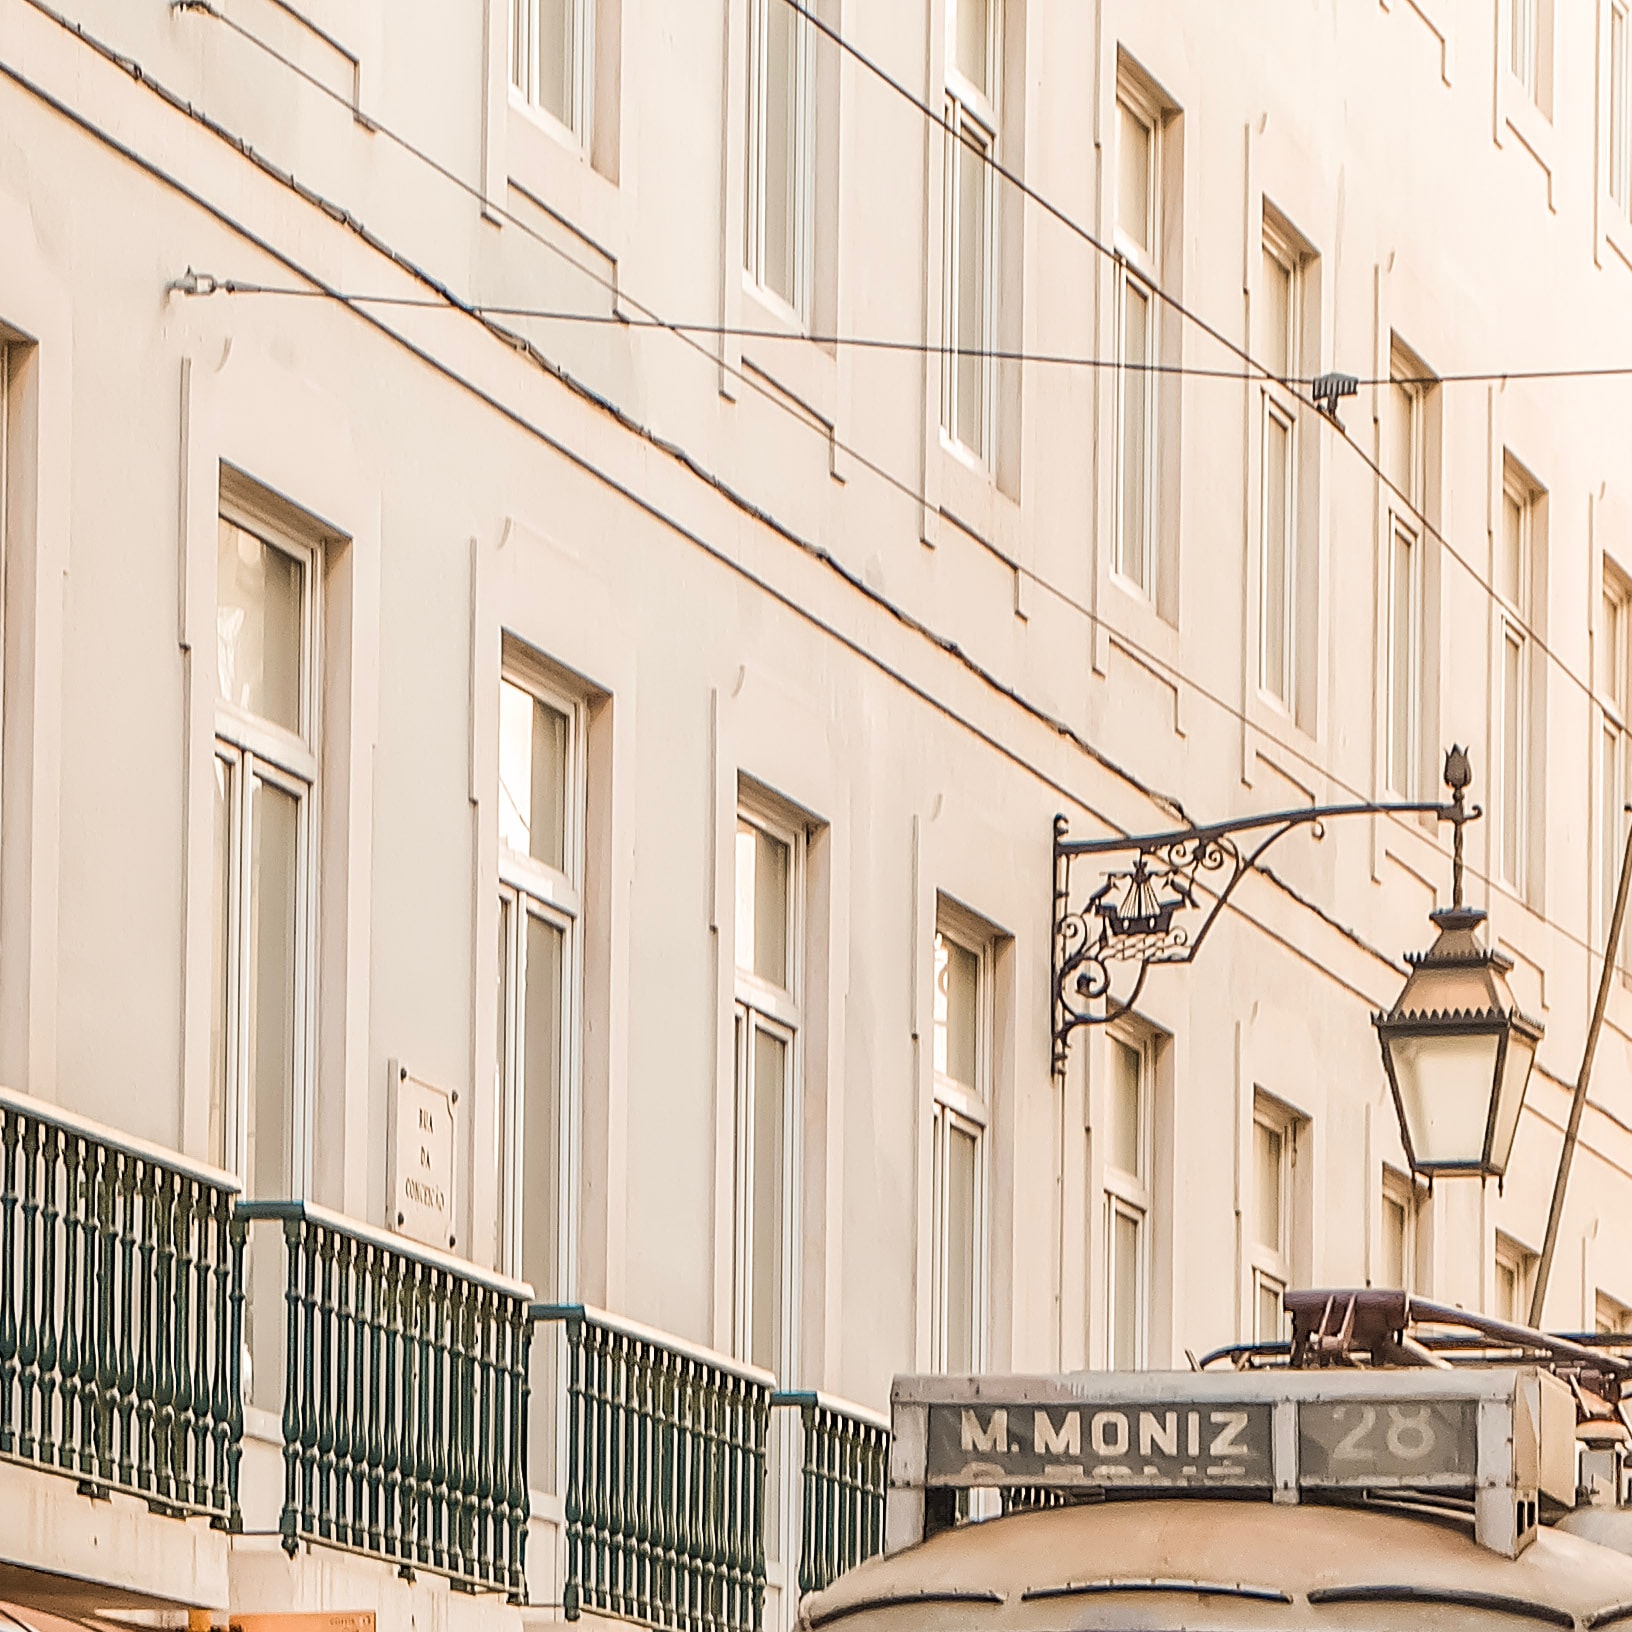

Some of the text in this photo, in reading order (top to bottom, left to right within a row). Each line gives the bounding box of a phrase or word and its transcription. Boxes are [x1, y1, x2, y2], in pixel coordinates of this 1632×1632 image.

[420, 1145, 431, 1171] DA
[960, 1408, 1249, 1457] M. MONIZ
[1332, 1405, 1436, 1461] 28
